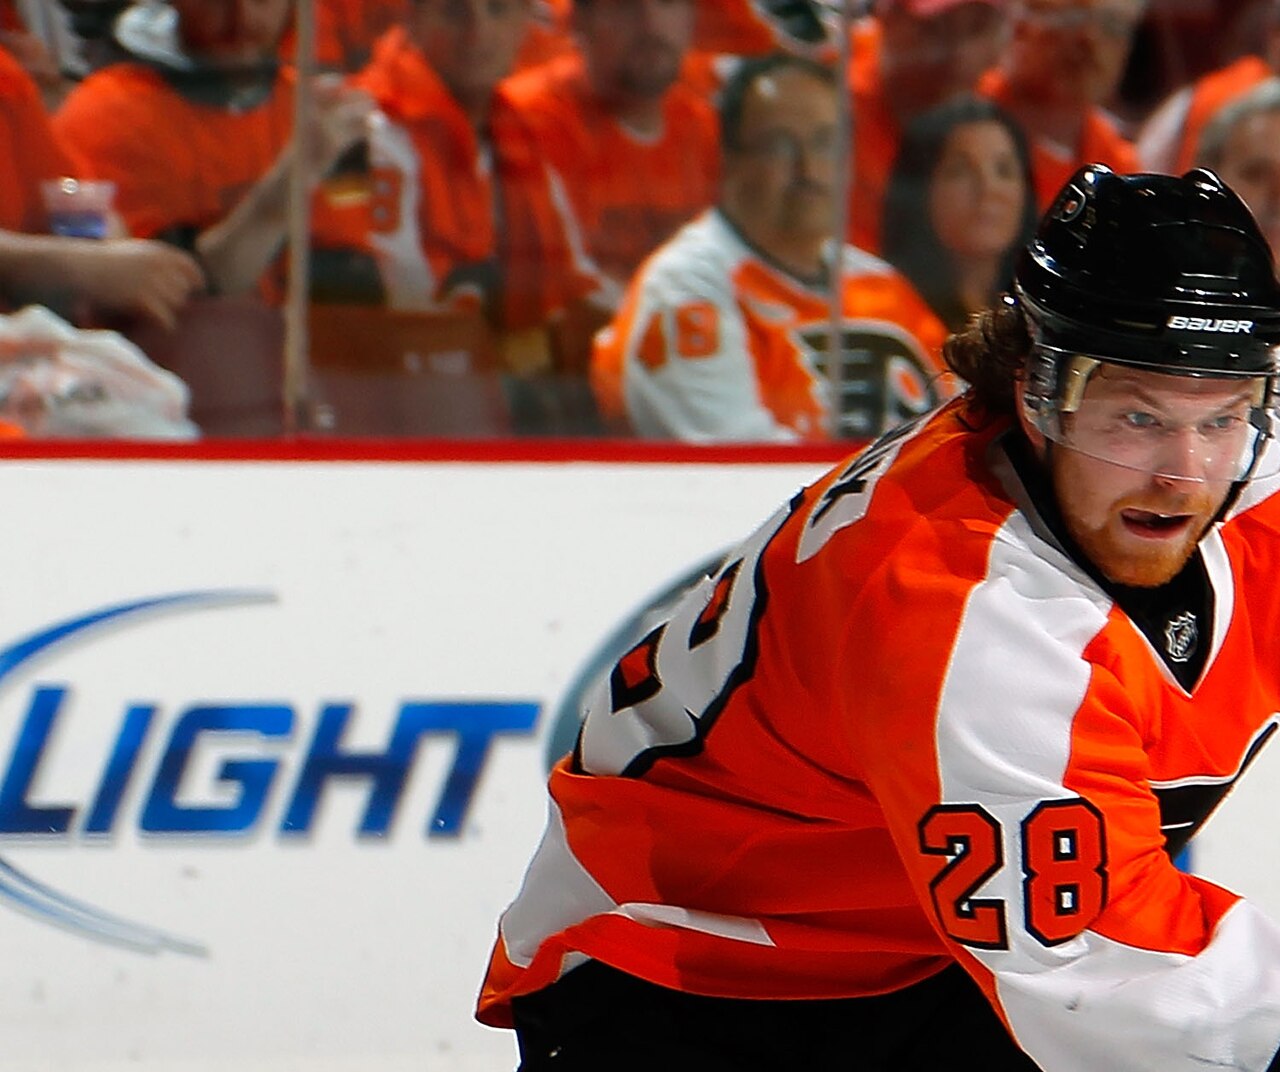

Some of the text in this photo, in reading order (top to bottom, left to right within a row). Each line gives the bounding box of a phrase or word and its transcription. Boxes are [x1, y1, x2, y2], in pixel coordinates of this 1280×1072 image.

[1166, 315, 1254, 334] BAUER
[0, 686, 542, 838] LIGHT
[918, 797, 1109, 950] 28
